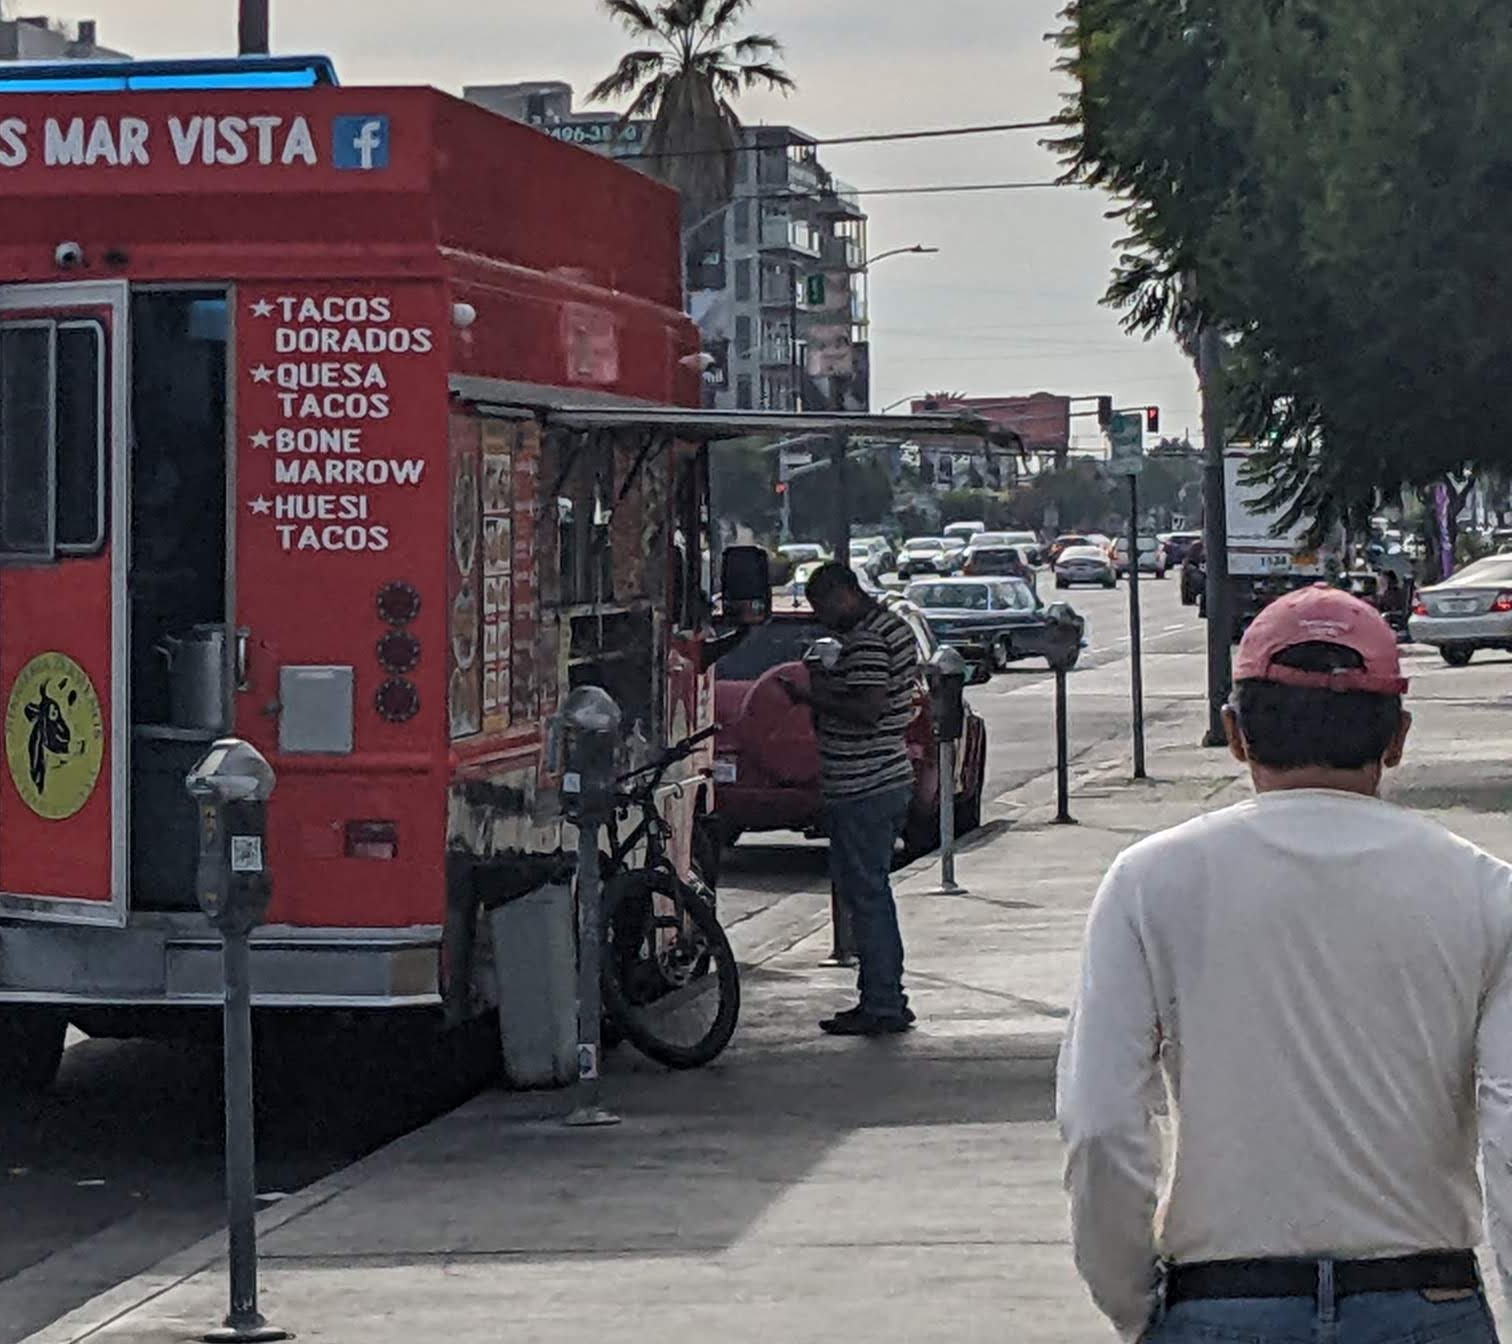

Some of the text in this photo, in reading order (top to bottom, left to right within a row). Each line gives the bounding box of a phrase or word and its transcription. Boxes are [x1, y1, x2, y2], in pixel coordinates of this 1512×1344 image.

[44, 117, 150, 167] MAR
[167, 116, 317, 166] VISTA
[276, 296, 391, 323] TACOS
[275, 327, 432, 353] DORADOS
[277, 362, 387, 391] QUESA
[277, 392, 390, 418] TACOS
[275, 428, 362, 453] BONE
[275, 459, 425, 485] MARROW
[275, 494, 367, 519] HUESI
[276, 525, 389, 551] TACOS
